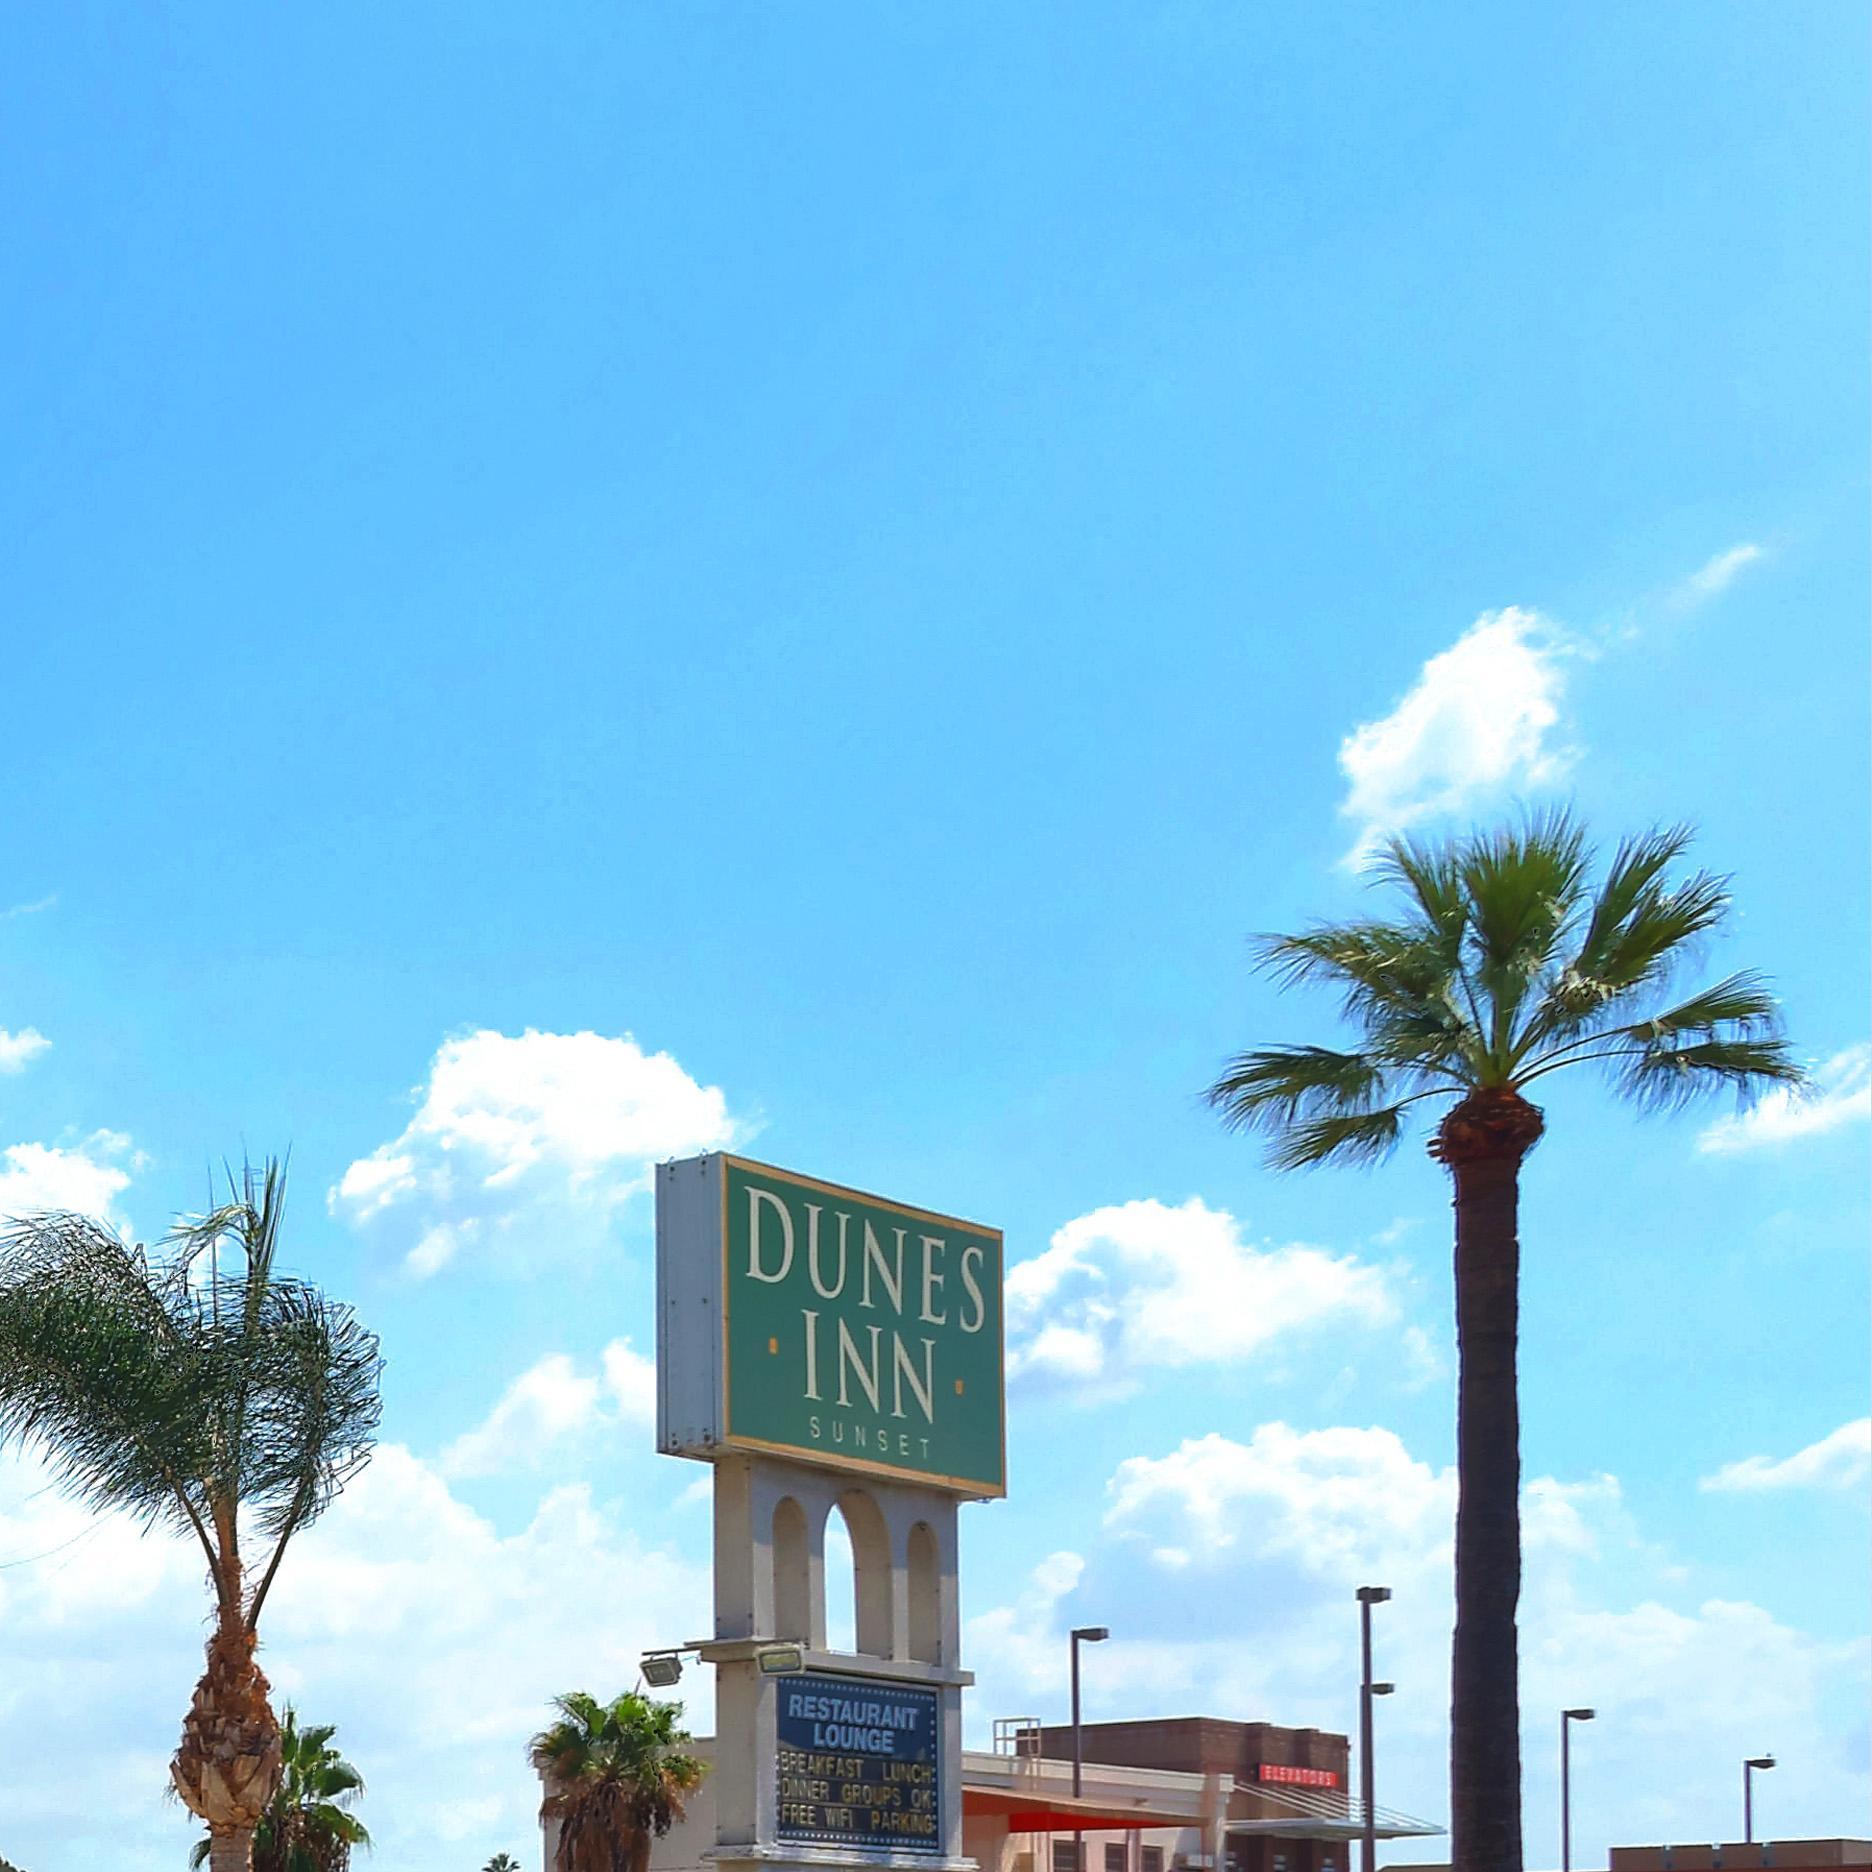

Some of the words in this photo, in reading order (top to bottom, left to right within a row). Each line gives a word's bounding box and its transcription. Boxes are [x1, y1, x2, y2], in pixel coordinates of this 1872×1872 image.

[744, 1185, 986, 1333] DUNES
[801, 1309, 936, 1424] INN
[809, 1415, 932, 1460] SUNSET
[788, 1694, 920, 1731] RESTAURANT
[813, 1722, 895, 1753] LOUNGE
[780, 1751, 864, 1779] BREAKFAST
[882, 1762, 932, 1784] LUNCH
[1265, 1765, 1333, 1786] ELEVATORS
[781, 1777, 830, 1800] DINNER
[841, 1783, 901, 1806] GROUPS
[911, 1790, 932, 1808] OK
[781, 1803, 816, 1825] FREE
[825, 1807, 854, 1828] WIFI
[871, 1810, 933, 1834] PARKING
